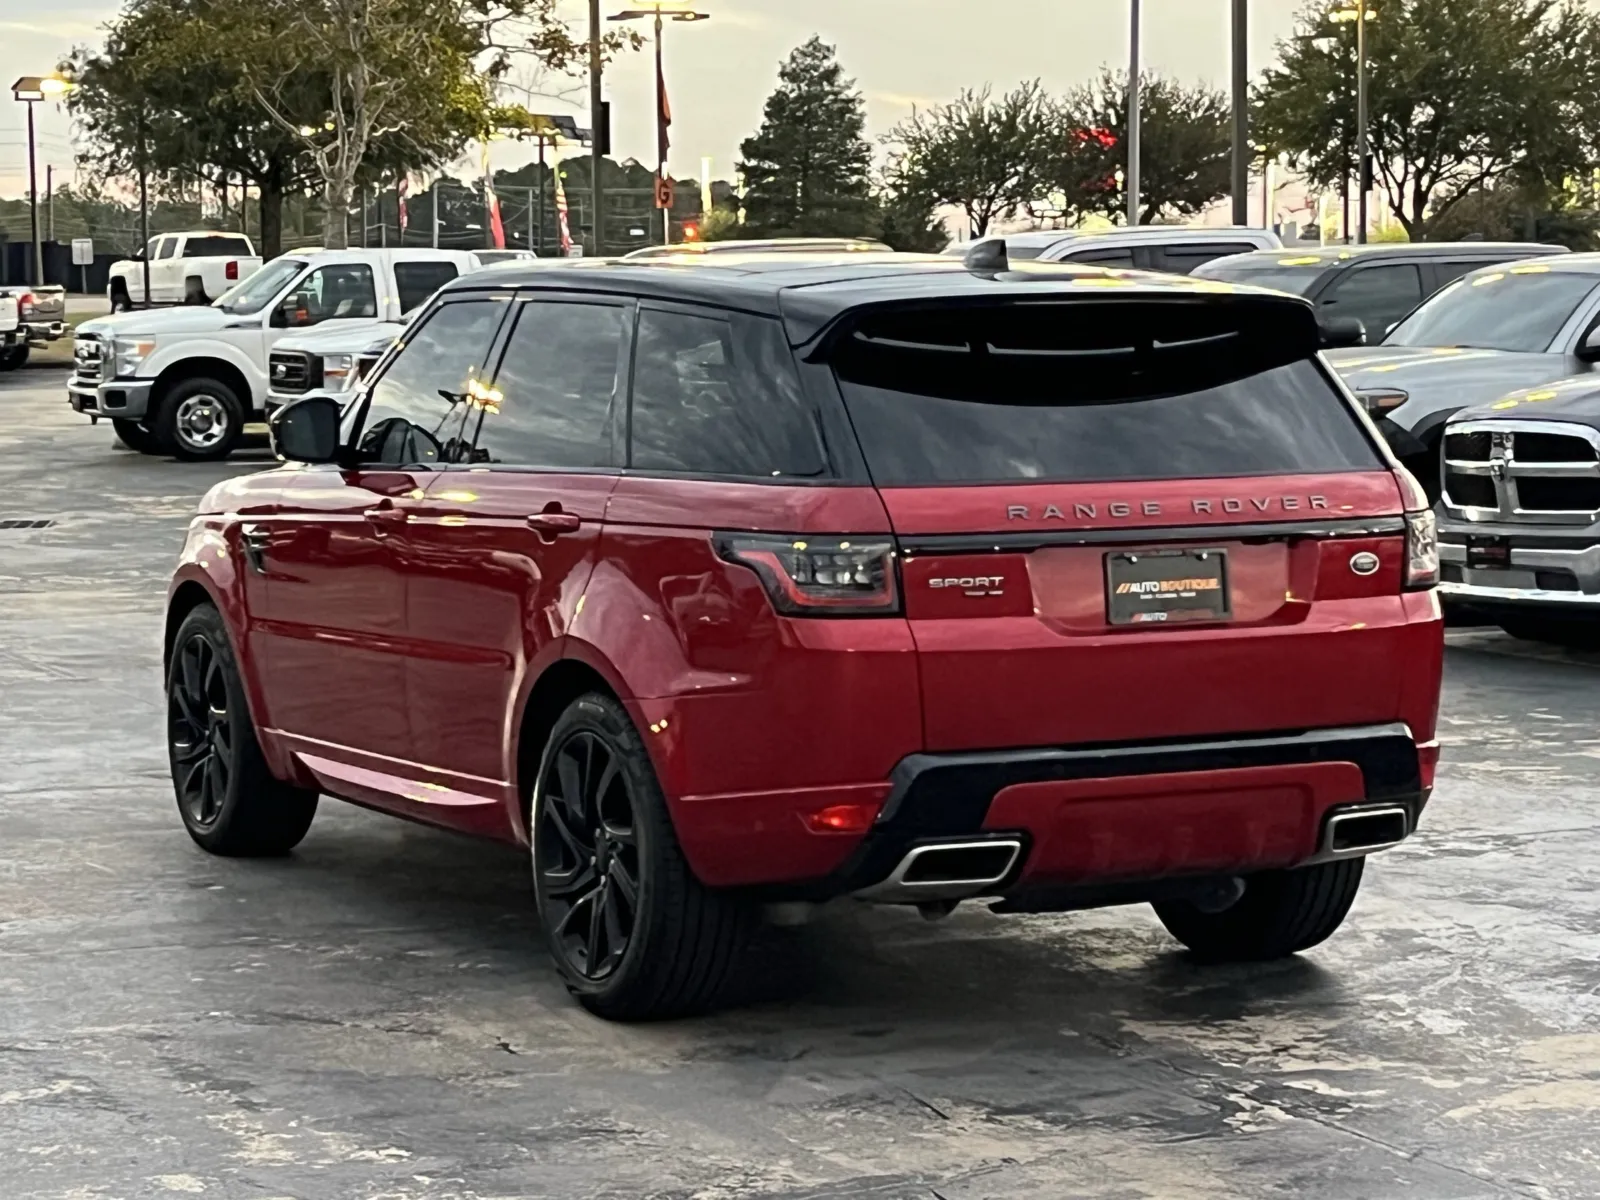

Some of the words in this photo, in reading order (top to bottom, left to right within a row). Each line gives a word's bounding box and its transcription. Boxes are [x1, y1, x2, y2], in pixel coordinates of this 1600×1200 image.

[1007, 501, 1162, 520] RANGE
[1192, 495, 1329, 514] ROVER
[928, 576, 1005, 588] SPORT
